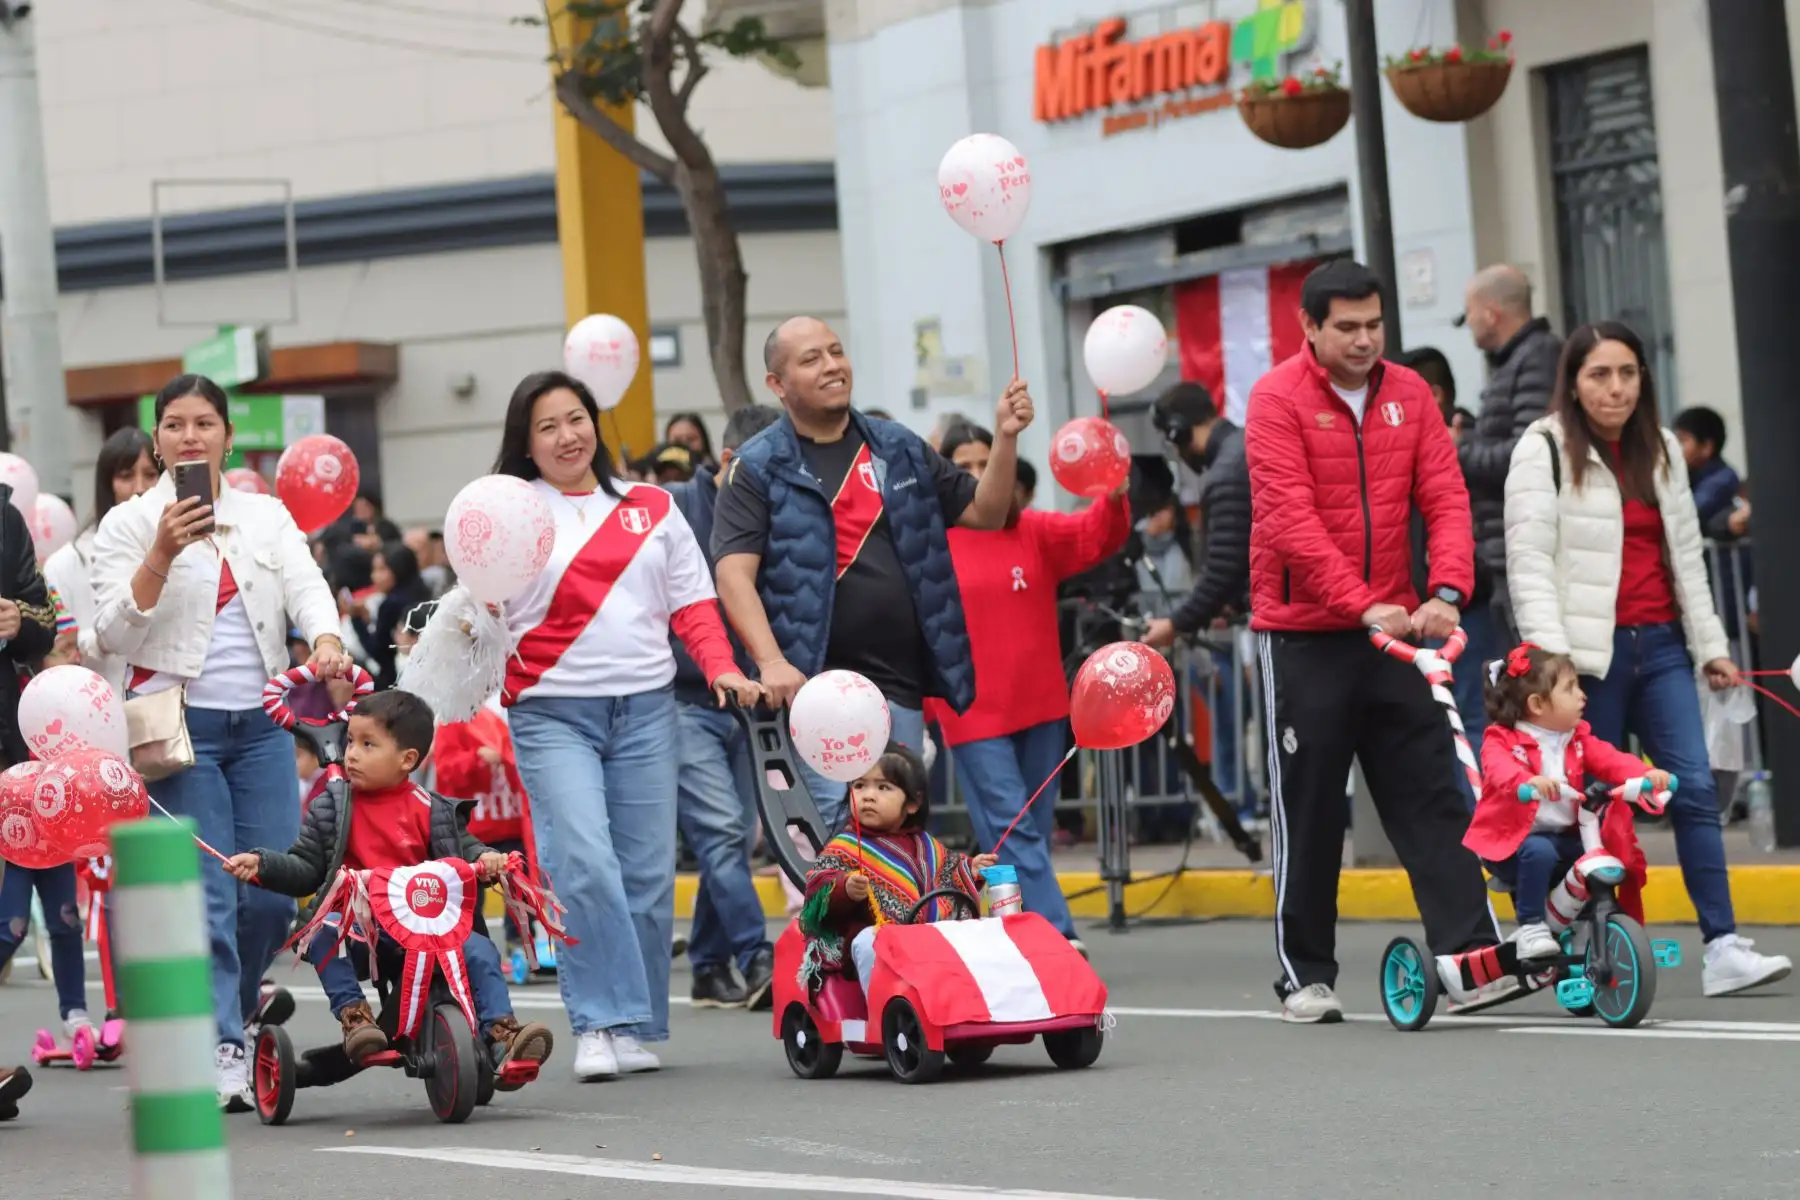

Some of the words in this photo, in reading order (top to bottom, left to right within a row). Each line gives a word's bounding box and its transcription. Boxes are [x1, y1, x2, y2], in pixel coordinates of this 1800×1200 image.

[1034, 17, 1231, 122] Mifarma
[91, 687, 113, 711] Per
[30, 733, 48, 748] Yo
[821, 738, 845, 751] Yo
[415, 877, 440, 889] VIVA
